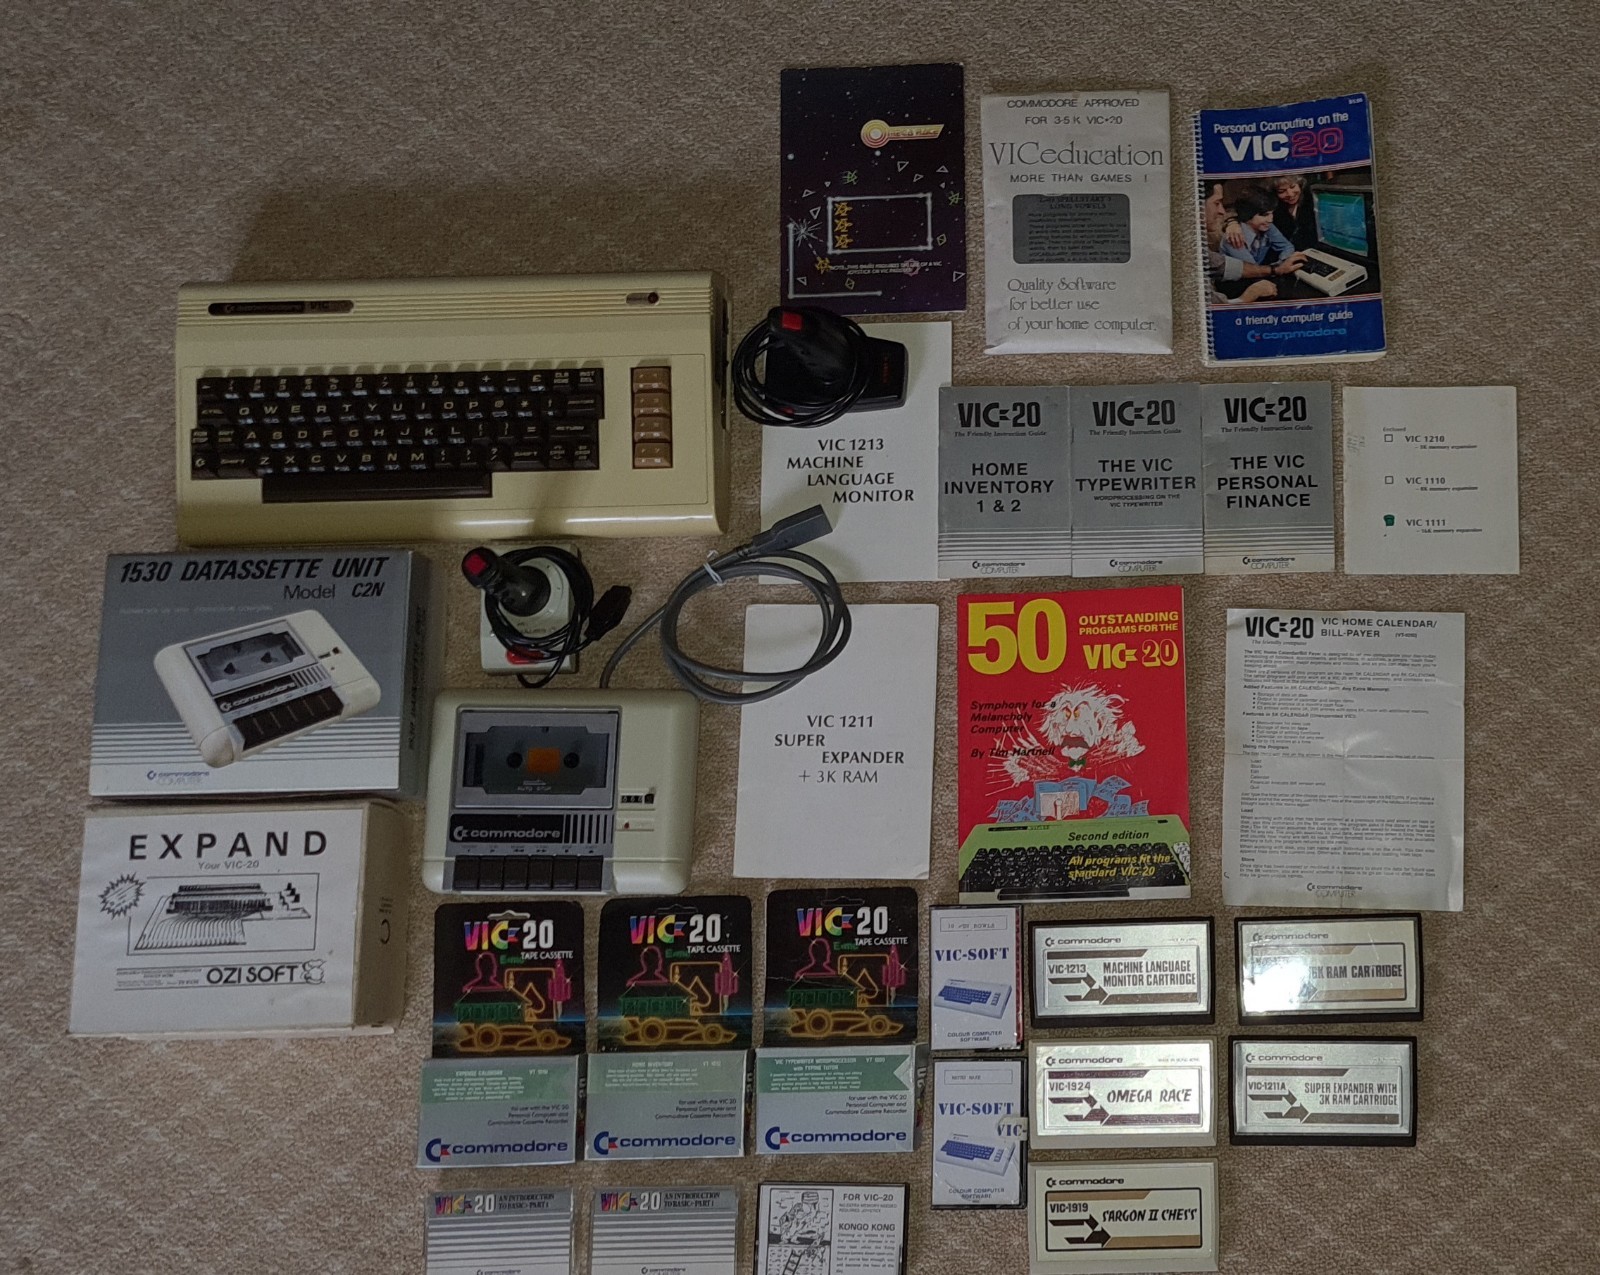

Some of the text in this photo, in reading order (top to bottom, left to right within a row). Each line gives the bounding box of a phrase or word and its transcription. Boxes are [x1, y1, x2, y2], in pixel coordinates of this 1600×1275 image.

[1007, 98, 1139, 108] COMMODORE APPROVED
[1025, 116, 1048, 124] FOR
[1213, 112, 1348, 134] Personal Computing on the
[989, 140, 1163, 166] VICeducation
[1010, 174, 1045, 183] MORE
[1052, 173, 1083, 182] THAN
[1090, 174, 1132, 182] GAMES
[1007, 277, 1117, 295] Quality Software
[1009, 297, 1100, 310] for better use
[1235, 309, 1354, 326] a friendly computer guide
[1008, 316, 1023, 330] of
[1025, 320, 1053, 334] your
[1056, 317, 1090, 330] home
[1262, 328, 1346, 340] commodore
[818, 438, 884, 451] VIC 1213
[1405, 435, 1445, 443] VIC 1210
[787, 456, 864, 469] MACHINE
[972, 462, 1028, 476] HOME
[1098, 458, 1173, 473] THE VIC
[1230, 455, 1305, 470] THE VIC
[807, 472, 895, 486] LANGUAGE
[1075, 476, 1196, 492] TYPEWRITER
[1217, 475, 1318, 490] PERSONAL
[1405, 477, 1422, 485] VIC
[944, 479, 1055, 495] INVENTORY
[832, 489, 914, 503] MONITOR
[1226, 494, 1311, 508] FINANCE
[977, 499, 1022, 512] 1 & 2
[120, 556, 390, 583] 1530 DATASSETTE UNIT
[283, 582, 385, 599] Model C2N
[1079, 611, 1179, 626] OUTSTANDING
[1321, 617, 1339, 625] VIC
[1342, 618, 1373, 626] HOME
[1376, 619, 1438, 628] CALENDAR/
[1079, 622, 1179, 635] PROGRAMS FOR THE
[1320, 628, 1380, 637] BILL-PAYER
[967, 598, 1067, 675] 50
[970, 699, 1048, 711] Symphony for
[806, 715, 874, 728] VIC 1211
[970, 712, 1032, 722] Melancholy
[970, 724, 1025, 734] Computer
[774, 734, 826, 747] SUPER
[822, 751, 905, 764] EXPANDER
[970, 747, 1056, 758] By Tim Hartnell
[842, 770, 878, 783] RAM
[470, 828, 561, 839] commodore
[1068, 830, 1149, 841] Second edition
[198, 860, 260, 871] Your VIC-20
[1068, 853, 1171, 867] All programs fit the
[1068, 867, 1117, 878] standard
[855, 938, 873, 946] TAPE
[873, 937, 909, 945] CASSETTE
[521, 950, 574, 959] TAPE CASSETTE
[687, 944, 741, 953] TAPE CASSETTE
[935, 947, 1010, 961] VIC-SOFT
[1048, 964, 1086, 974] VIC-1213
[1103, 960, 1191, 974] MACHINE LANGUAGE
[1326, 966, 1348, 979] RAM
[1351, 964, 1403, 978] CARTRIDGE
[1103, 973, 1196, 987] MONITOR CARTRIDGE
[1258, 1054, 1323, 1062] commodore
[1050, 1081, 1091, 1091] VIC-1924
[1248, 1082, 1286, 1091] VIC-1211A
[1304, 1083, 1398, 1094] SUPER EXPANDER WITH
[1107, 1088, 1192, 1102] OMEGA RACE
[1319, 1094, 1398, 1106] 3K RAM CARTRIDGE
[938, 1103, 1014, 1115] VIC-SOFT
[619, 1134, 736, 1147] commodore
[791, 1129, 907, 1142] commodore
[452, 1140, 568, 1154] commodore
[1059, 1177, 1124, 1186] commodore
[1050, 1202, 1089, 1213] VIC-1919
[1102, 1208, 1198, 1222] SARGON II CHESS
[839, 1223, 896, 1231] KONGO KONG
